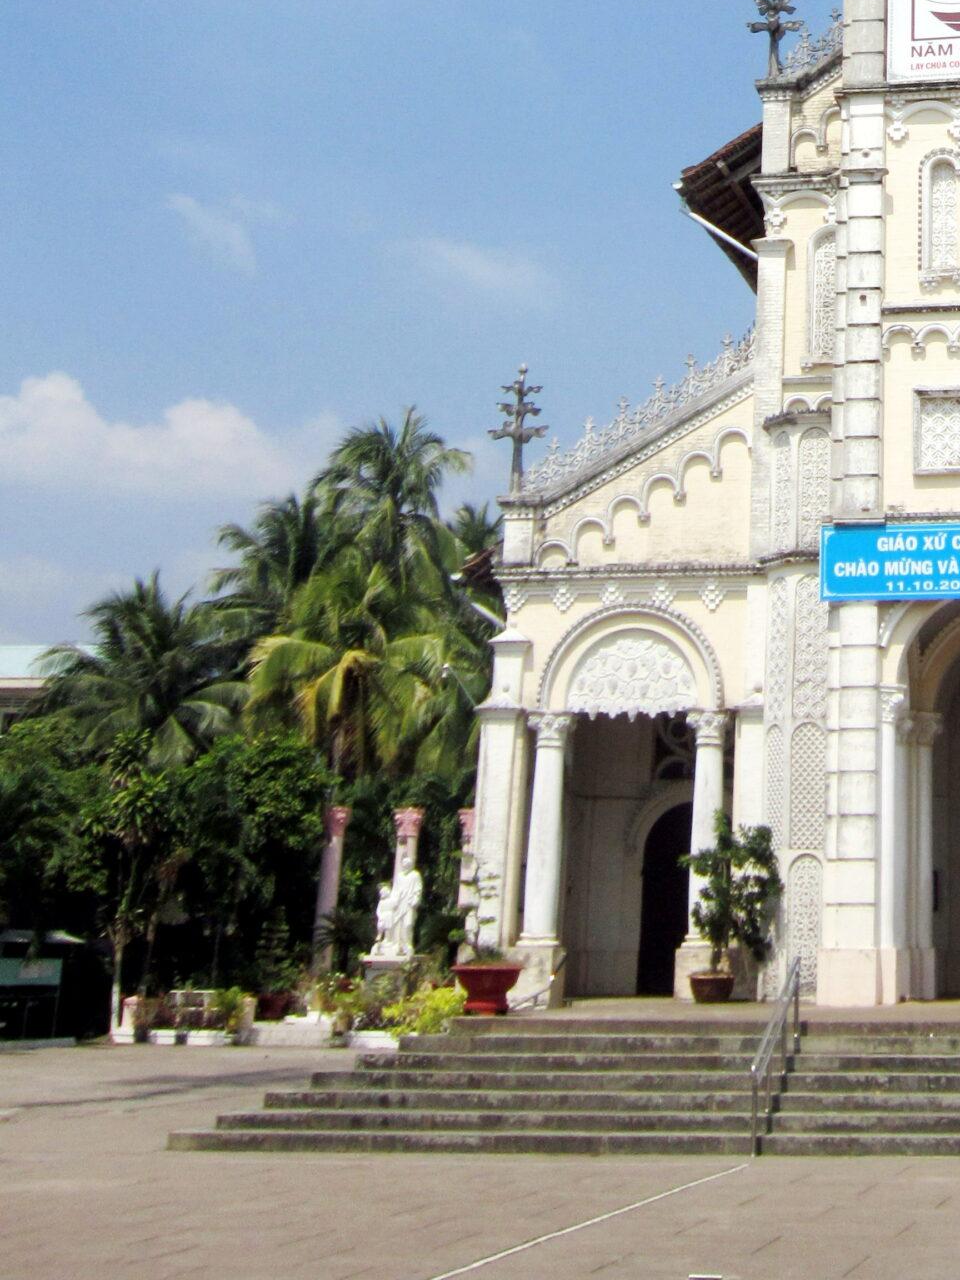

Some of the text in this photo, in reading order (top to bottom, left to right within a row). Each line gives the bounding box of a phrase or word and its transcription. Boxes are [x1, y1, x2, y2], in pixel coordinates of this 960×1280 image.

[911, 41, 953, 58] NĂM
[877, 533, 918, 552] GIÁO
[923, 532, 947, 551] XỨ
[834, 558, 879, 577] CHÀO
[884, 557, 933, 576] MỪNG
[937, 557, 959, 575] VÀ
